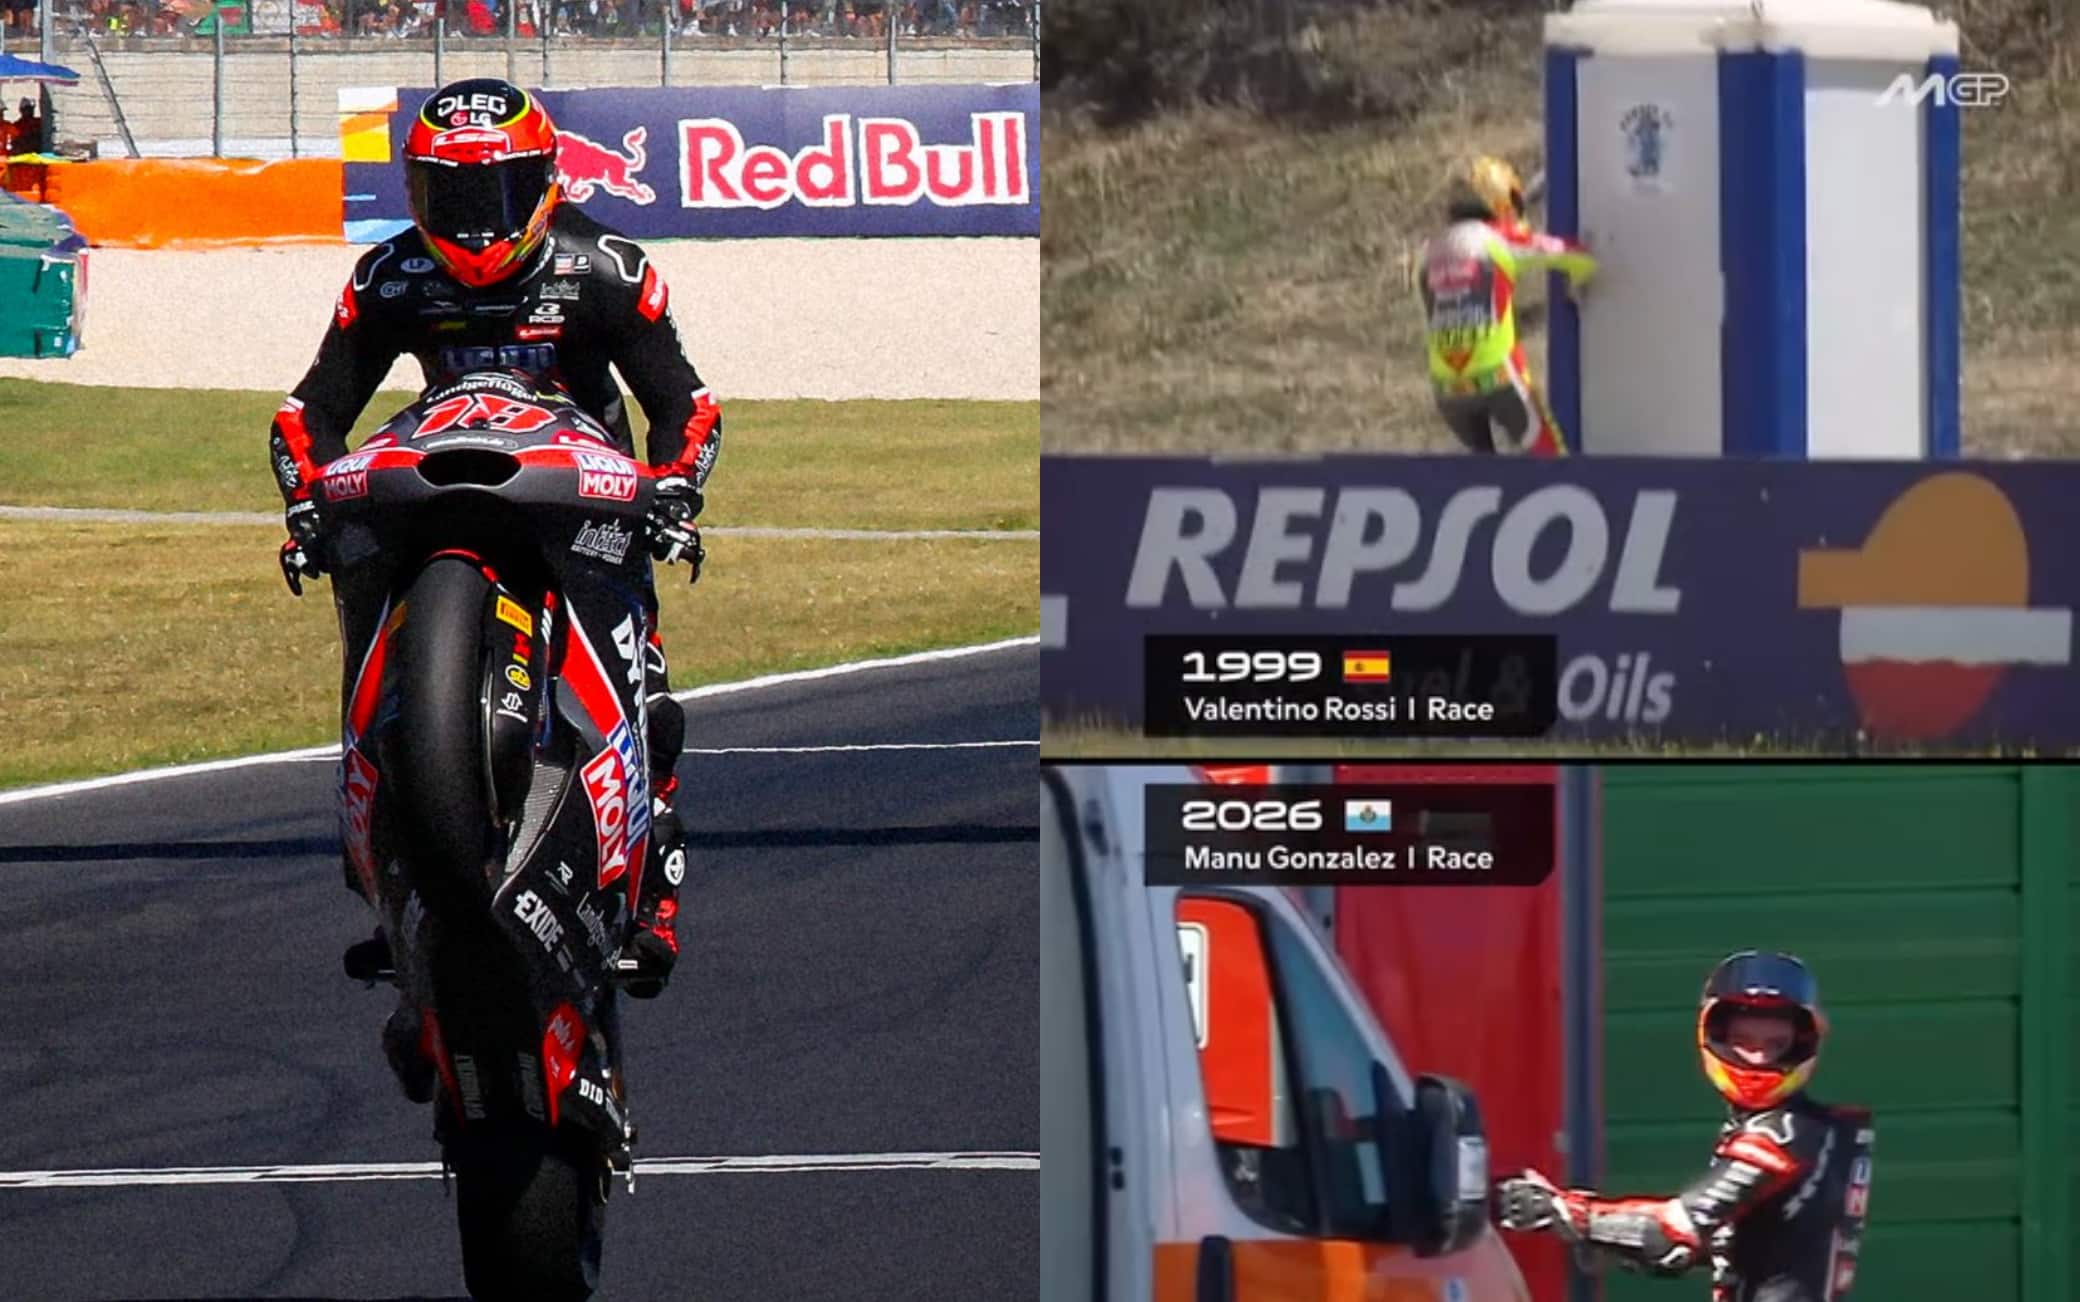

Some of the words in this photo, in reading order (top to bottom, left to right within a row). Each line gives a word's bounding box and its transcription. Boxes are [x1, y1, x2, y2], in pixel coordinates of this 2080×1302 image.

[680, 115, 855, 208] Red
[859, 113, 1028, 204] Bull
[582, 471, 635, 497] MOLY
[1125, 484, 1682, 616] REPSOL
[1556, 651, 1676, 724] Oils
[587, 755, 626, 874] MOLY
[513, 889, 564, 953] EXIDE
